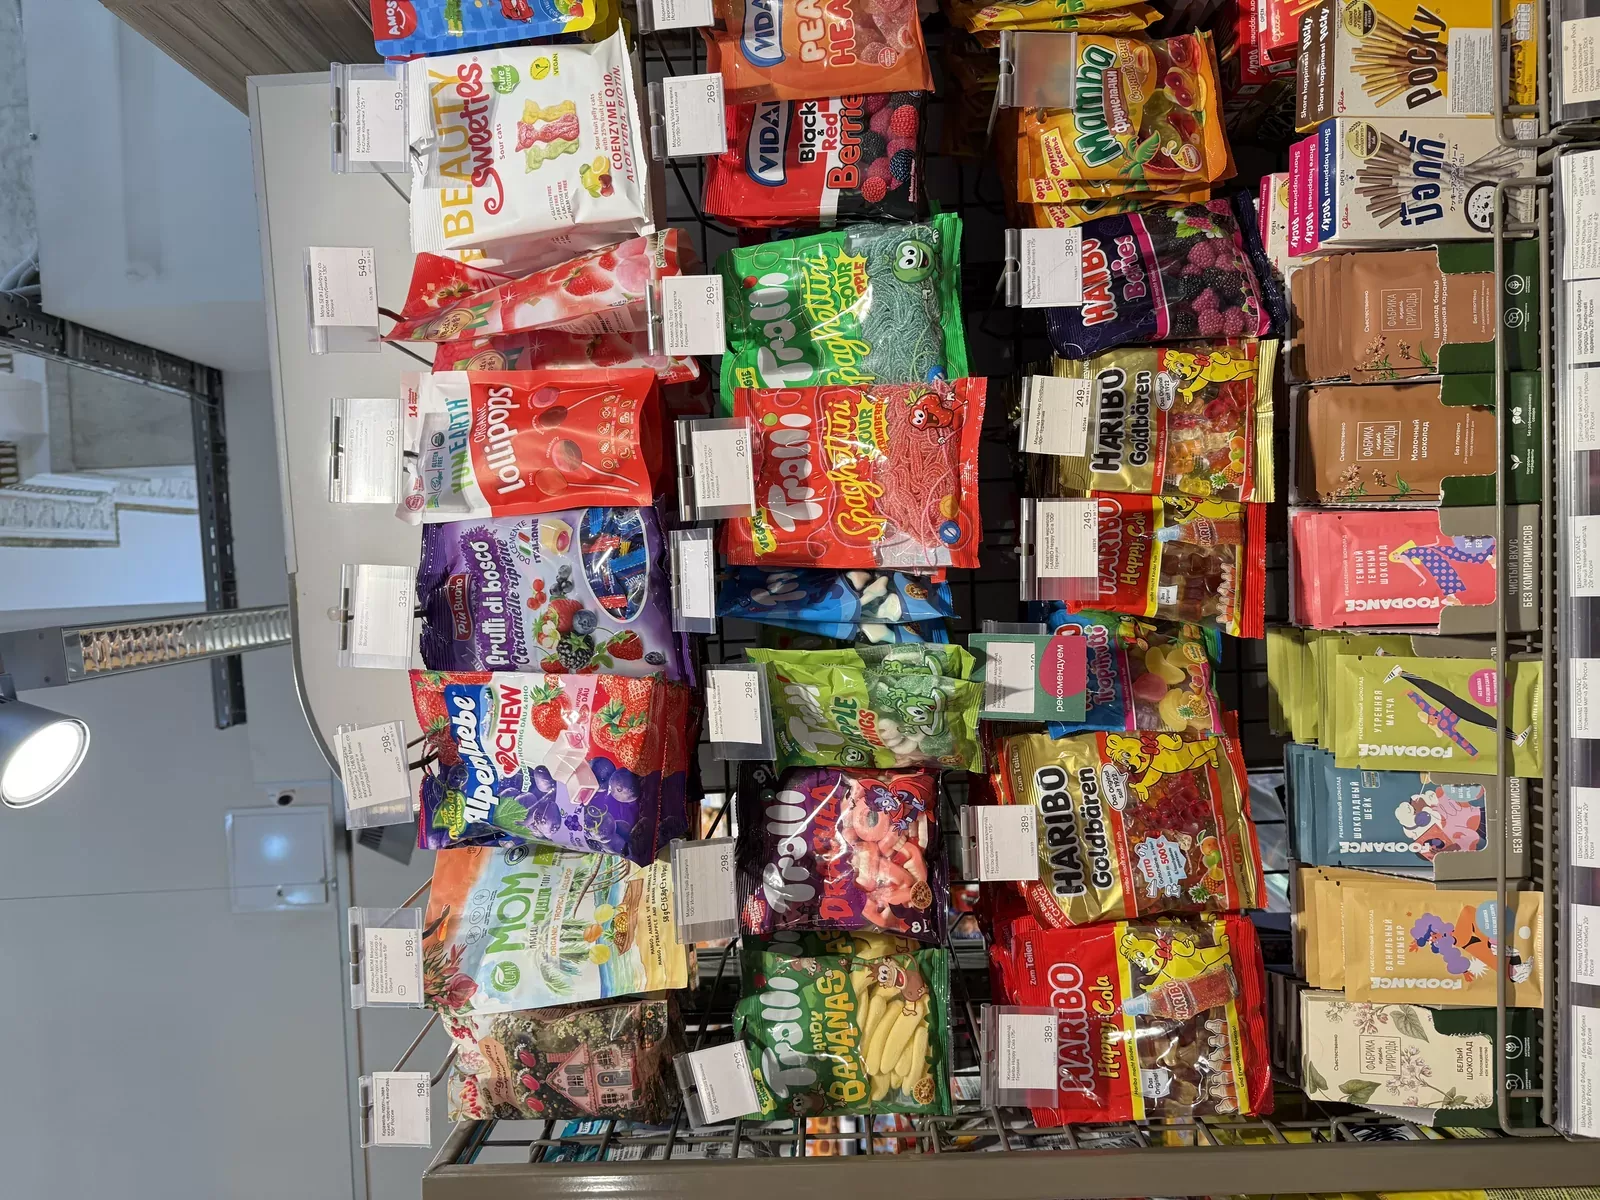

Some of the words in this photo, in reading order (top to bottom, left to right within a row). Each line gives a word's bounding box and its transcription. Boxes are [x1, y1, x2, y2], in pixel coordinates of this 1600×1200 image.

[497, 70, 506, 91] Pure
[504, 66, 514, 92] Nature
[612, 64, 625, 108] BIOTIN.
[1074, 44, 1124, 168] Mamba
[1337, 90, 1346, 113] Glico
[456, 63, 504, 215] Sweeties
[606, 100, 624, 170] COENZYME
[800, 102, 817, 162] Black
[818, 128, 825, 136] &
[822, 114, 838, 150] Red
[828, 94, 864, 188] Berrie
[1322, 128, 1332, 153] Share
[427, 68, 475, 239] BEAUTY
[497, 140, 506, 160] Sour
[624, 148, 635, 183] ALOE
[1322, 154, 1332, 196] happiness!
[549, 197, 558, 216] GLUTEN
[559, 193, 568, 215] LACTOSE
[1342, 207, 1351, 229] Glico
[1406, 292, 1418, 326] ПРИРОДЫ
[1432, 280, 1440, 304] белый
[800, 254, 876, 386] Spaghettini
[1387, 294, 1397, 326] ФАБРИКА
[742, 272, 814, 388] Trolli
[408, 405, 418, 418] 14
[473, 402, 487, 443] ORGANIC
[1088, 366, 1127, 473] HARIBO
[1128, 370, 1152, 466] Goldbären
[446, 398, 474, 494] YUMEARTH
[858, 408, 876, 455] SOUR
[1362, 426, 1374, 457] ФАБРИКА
[1382, 425, 1398, 456] ПРИРОДЫ
[1410, 419, 1420, 461] Молочный
[1422, 422, 1430, 458] шоколад
[762, 412, 824, 532] Trolli
[823, 399, 888, 540] Spaghettini
[508, 519, 531, 565] DOLCEMENTE
[1098, 498, 1122, 594] HARIBO
[1508, 538, 1519, 560] ВКУС
[1522, 525, 1533, 590] КОМПРОМИССОВ
[1574, 535, 1582, 564] FOODANCE
[470, 540, 502, 592] bosco
[496, 539, 522, 590] ripiene
[1354, 550, 1365, 584] ТЕМНЫЙ
[1366, 550, 1376, 584] ТЕМНЫЙ
[1378, 544, 1389, 584] ШОКОЛАД
[1508, 561, 1519, 595] ЧИСТЫЙ
[453, 578, 465, 610] Buono
[481, 598, 504, 614] di
[1344, 596, 1440, 612] FOODANCE
[1522, 592, 1533, 608] БЕЗ
[457, 612, 469, 635] Più
[505, 591, 530, 665] Caramelle
[481, 618, 510, 665] frutti
[1055, 644, 1066, 712] рекомендуем
[1374, 690, 1383, 733] УТРЕННЯЯ
[1386, 698, 1395, 726] МАТЧА
[452, 694, 500, 823] Alpenliebe
[1012, 744, 1021, 774] Teilen
[1358, 743, 1453, 758] FOODANCE
[1016, 775, 1024, 792] Zum
[1103, 770, 1116, 794] Original
[1112, 773, 1121, 788] 1922
[1116, 788, 1124, 799] seit
[1110, 794, 1118, 806] Das
[1350, 781, 1362, 839] ШОКОЛАДНЫЙ
[1362, 797, 1373, 820] ШЕЙК
[1510, 776, 1522, 836] КОМПРОМИССО
[1034, 765, 1087, 896] HARIBO
[1078, 767, 1114, 890] Goldbären
[762, 790, 816, 914] Trolli
[1338, 841, 1430, 854] FOODANCE
[1513, 838, 1523, 854] БЕЗ
[561, 867, 573, 890] LOLLIPOP
[1143, 858, 1155, 878] OTTO
[484, 872, 540, 955] MOM
[553, 892, 566, 921] TROPICAL
[1031, 888, 1047, 912] BEUTEL
[1045, 911, 1063, 928] JEDER
[550, 925, 560, 956] ORGANIC
[1024, 940, 1034, 968] Teilen
[1383, 919, 1394, 971] ВАНИЛЬНЫЙ
[1396, 924, 1406, 966] ПЛОМБИР
[503, 964, 517, 990] VEGAN
[1029, 970, 1037, 985] Zum
[1370, 976, 1463, 990] FOODANCE
[1088, 975, 1116, 1016] Cola
[1165, 980, 1188, 1019] HARIBO
[754, 974, 817, 1098] Trolli
[816, 970, 866, 1102] BANANAS
[1048, 963, 1095, 1091] HARIBO
[1098, 1022, 1121, 1078] Happy
[1365, 1040, 1376, 1070] ФАБРИКА
[1384, 1040, 1398, 1072] ПРИРОДЫ
[1454, 1048, 1464, 1073] БЕЛЫЙ
[1466, 1041, 1474, 1080] ШОКОЛАД
